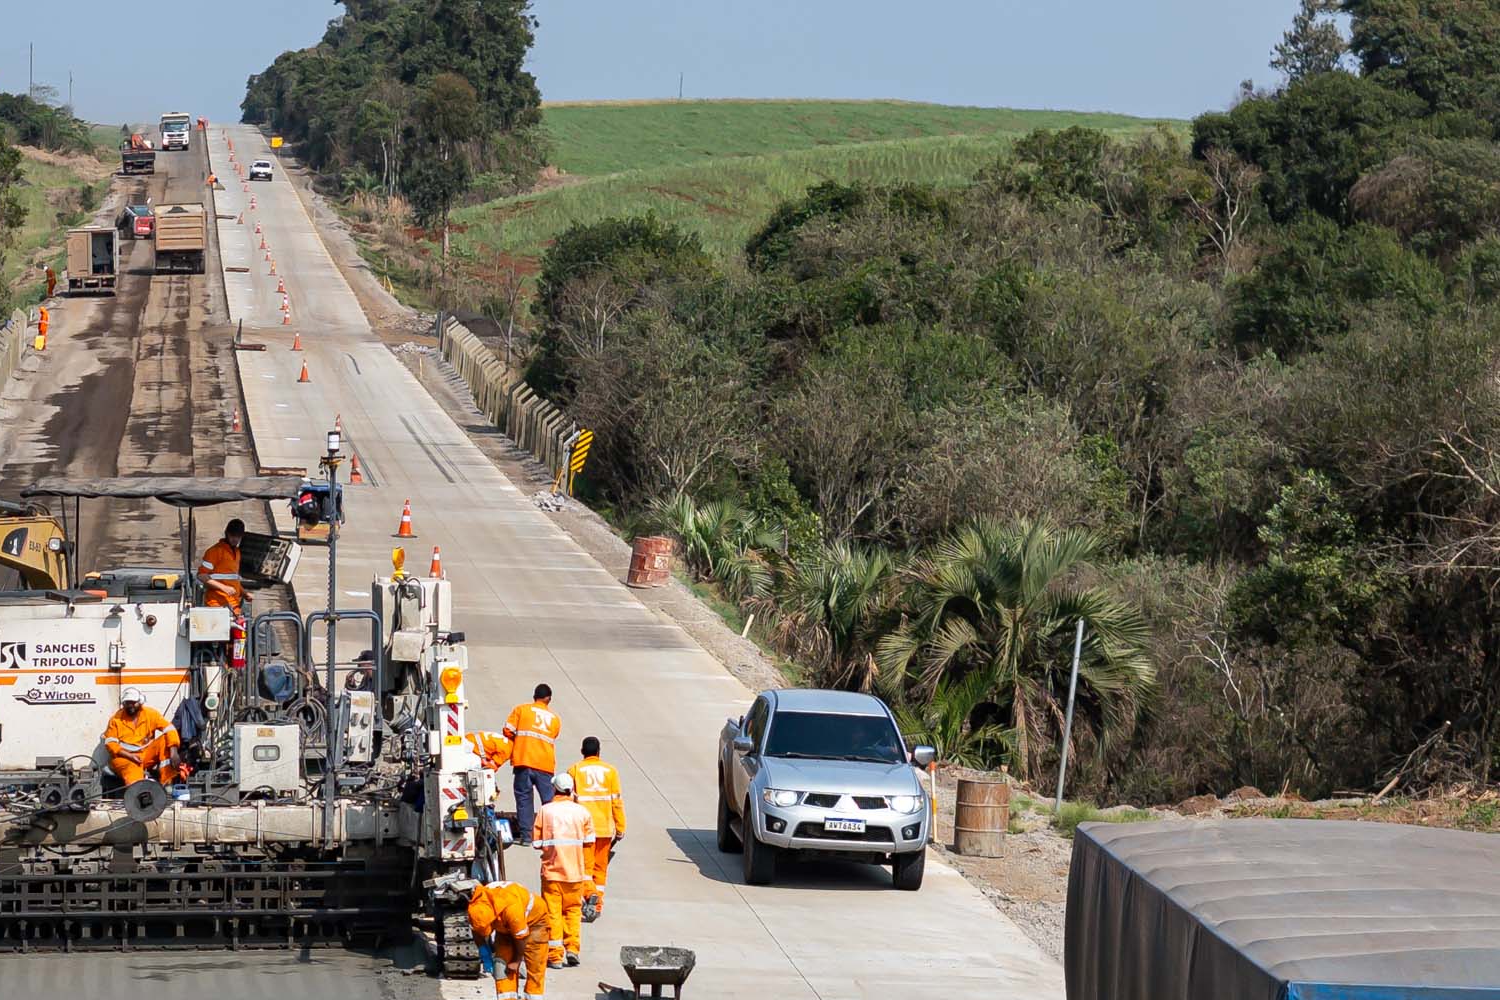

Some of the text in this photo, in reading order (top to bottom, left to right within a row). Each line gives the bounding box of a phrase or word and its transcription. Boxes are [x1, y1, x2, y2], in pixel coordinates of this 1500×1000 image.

[35, 644, 96, 653] SANCHES
[32, 657, 98, 667] TRIPOLONI
[37, 674, 75, 685] SP 500
[44, 691, 92, 701] Wirtgen
